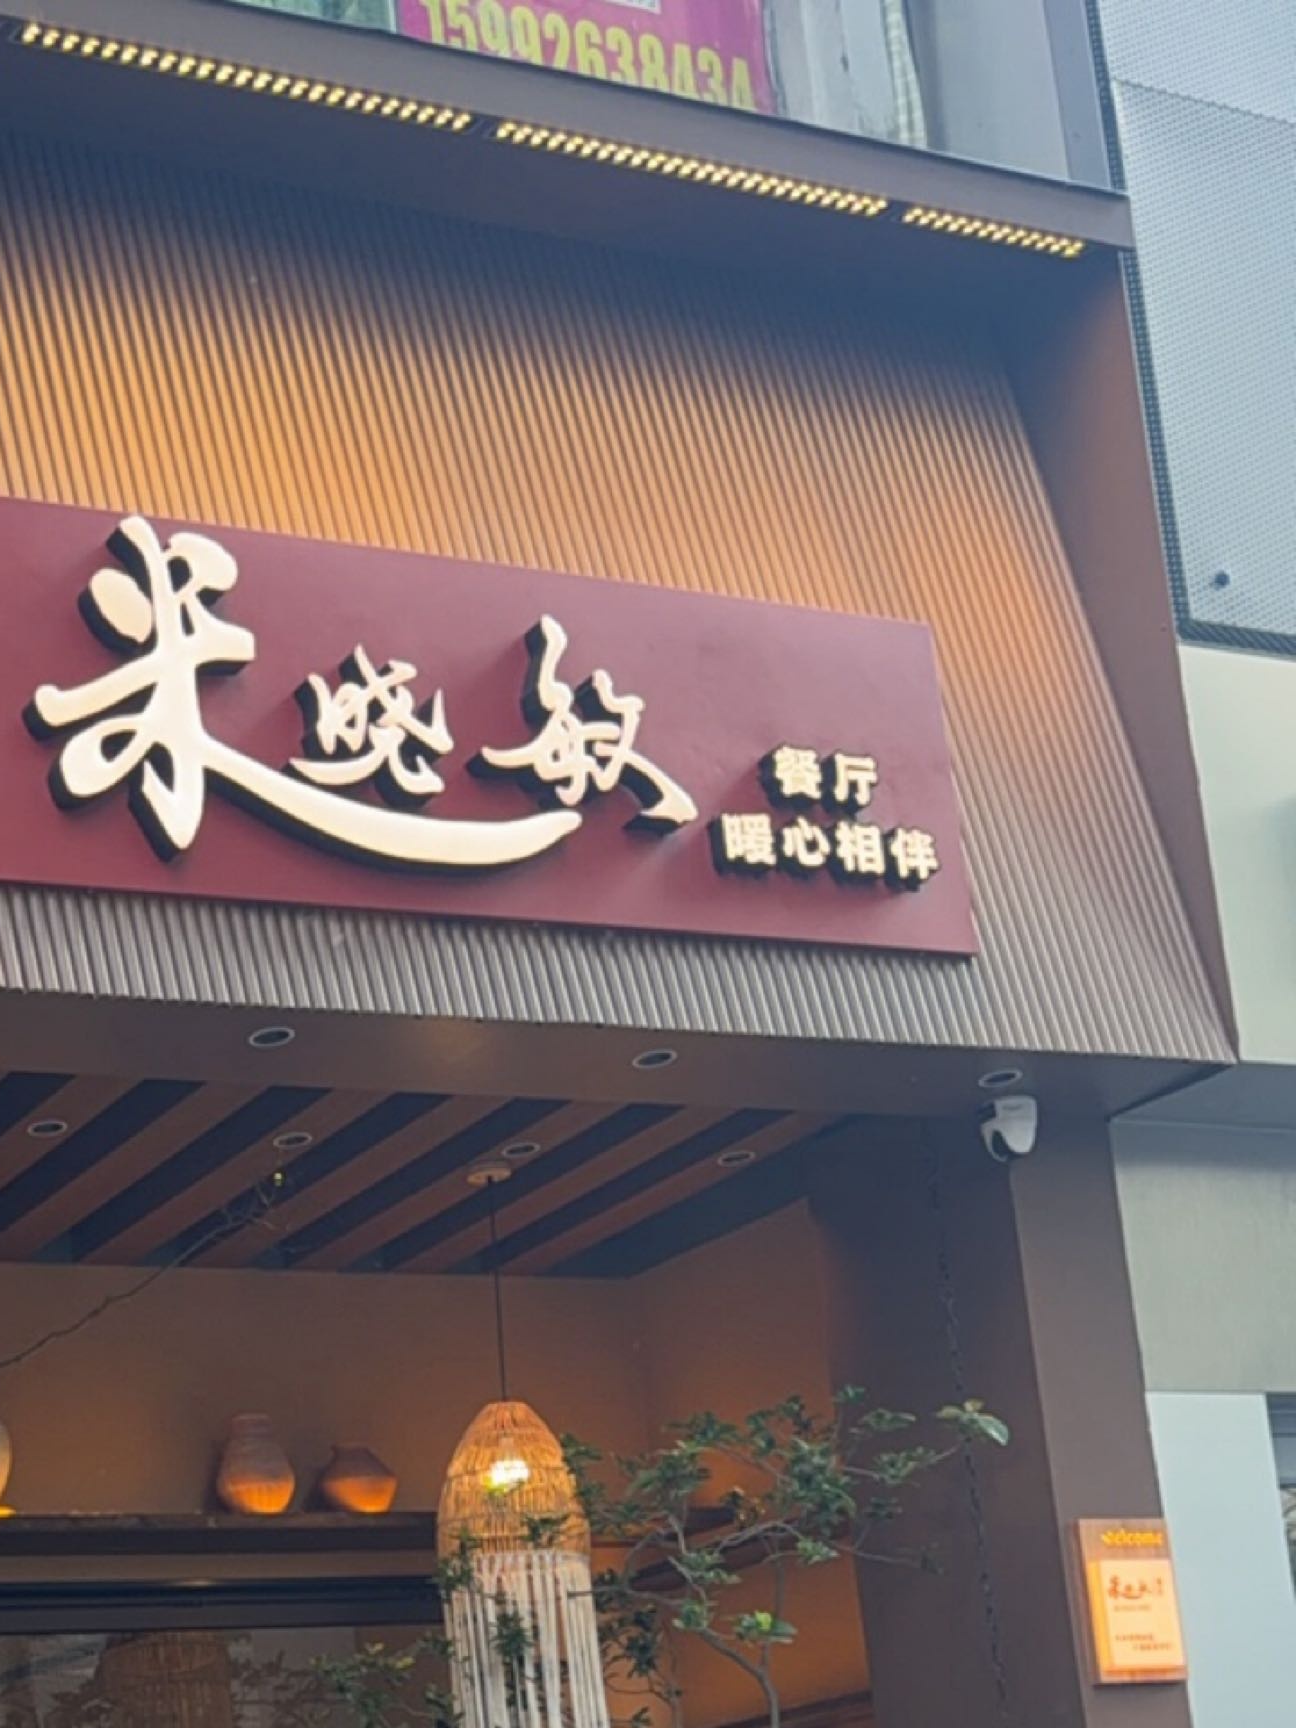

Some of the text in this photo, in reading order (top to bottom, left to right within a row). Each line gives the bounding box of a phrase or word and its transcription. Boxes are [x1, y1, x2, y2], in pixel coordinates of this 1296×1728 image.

[32, 514, 698, 867] 米晓敏
[772, 745, 878, 806] 餐厅
[720, 812, 940, 880] 暖心相伴
